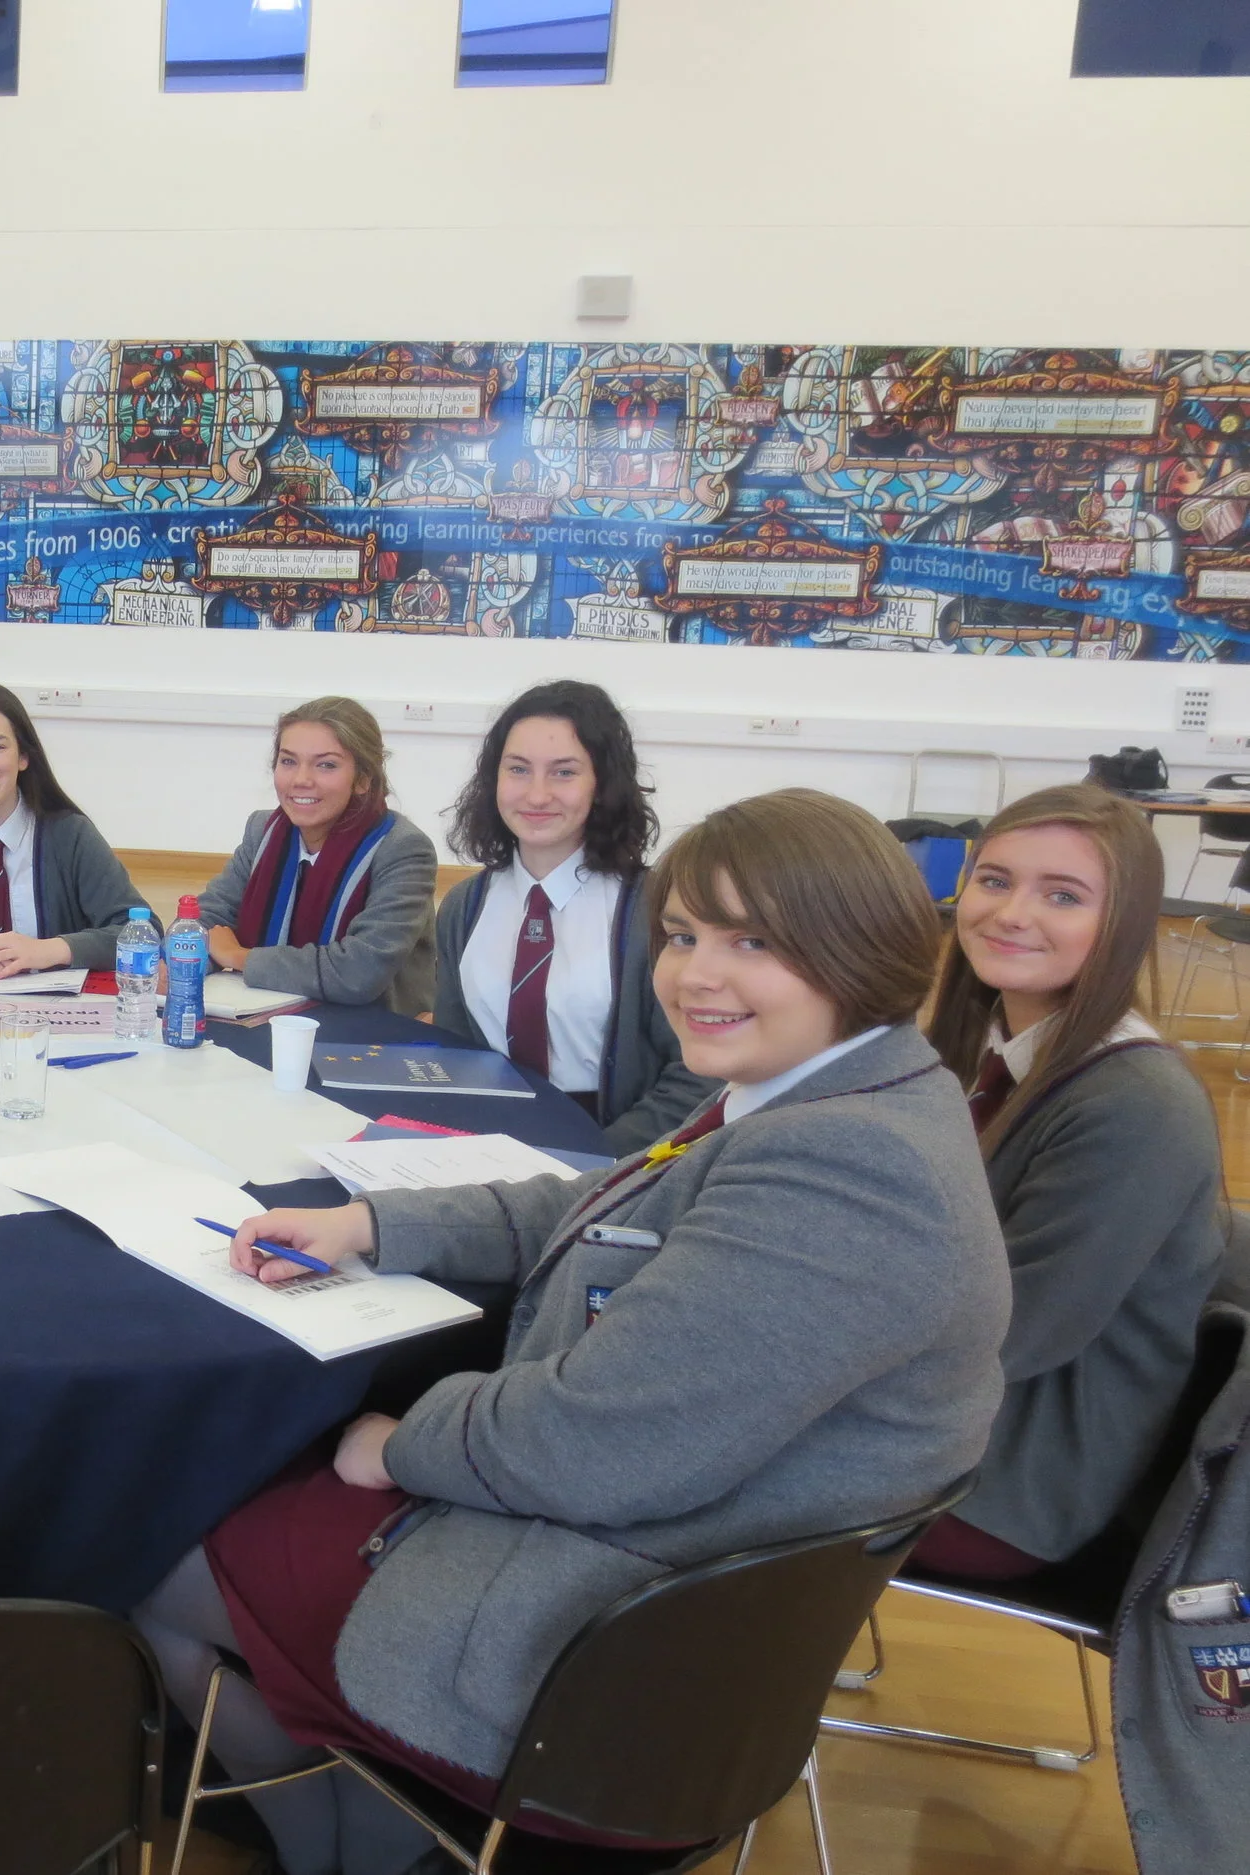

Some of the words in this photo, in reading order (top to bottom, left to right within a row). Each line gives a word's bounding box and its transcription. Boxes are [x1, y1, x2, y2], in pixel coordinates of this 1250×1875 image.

[322, 391, 334, 400] No
[336, 391, 367, 403] pleasure
[370, 391, 376, 400] is
[420, 392, 428, 401] to
[430, 392, 440, 401] the
[322, 406, 341, 414] upon
[342, 404, 354, 412] the
[392, 404, 423, 415] ground
[425, 404, 433, 413] of
[436, 404, 460, 413] Truth
[727, 403, 770, 414] BUNSEN
[964, 402, 1001, 413] Nature
[1004, 404, 1035, 413] never
[1038, 402, 1054, 413] did
[1056, 403, 1094, 416] betray
[1096, 403, 1113, 414] the
[1114, 403, 1148, 414] heart
[964, 417, 986, 428] that
[989, 417, 1022, 428] loved
[1026, 418, 1046, 428] her
[757, 452, 795, 464] CHEMISTR
[499, 500, 544, 511] PASTEUR
[218, 552, 230, 561] Do
[232, 552, 246, 561] not
[249, 553, 290, 564] squander
[294, 553, 310, 562] time
[314, 553, 324, 562] for
[328, 554, 344, 562] that
[346, 554, 354, 562] is
[1051, 545, 1119, 559] SHAKESPEARE
[24, 530, 77, 557] from
[87, 525, 141, 551] 1906
[168, 518, 238, 543] creati
[418, 516, 503, 547] learning
[524, 521, 628, 548] xperiences
[889, 554, 1013, 592] outstanding
[1021, 564, 1131, 613] learng
[216, 564, 229, 572] the
[232, 564, 252, 572] stuff
[254, 564, 266, 573] life
[269, 564, 277, 573] is
[280, 565, 304, 573] made
[308, 565, 316, 573] of
[686, 565, 700, 575] He
[702, 565, 724, 576] who
[726, 566, 760, 576] would
[760, 567, 796, 577] search
[800, 567, 814, 577] for
[816, 568, 852, 581] pearls
[686, 579, 714, 589] must
[716, 580, 742, 589] dive
[744, 580, 780, 590] below
[15, 590, 50, 600] TURNER
[122, 594, 193, 613] MECHANICAL
[881, 600, 917, 617] URAL
[589, 608, 650, 629] PHYSICS
[578, 622, 615, 636] ELECTRICAL
[615, 627, 661, 640] ENGINEERING
[403, 1059, 430, 1081] Europe
[427, 1061, 451, 1081] House
